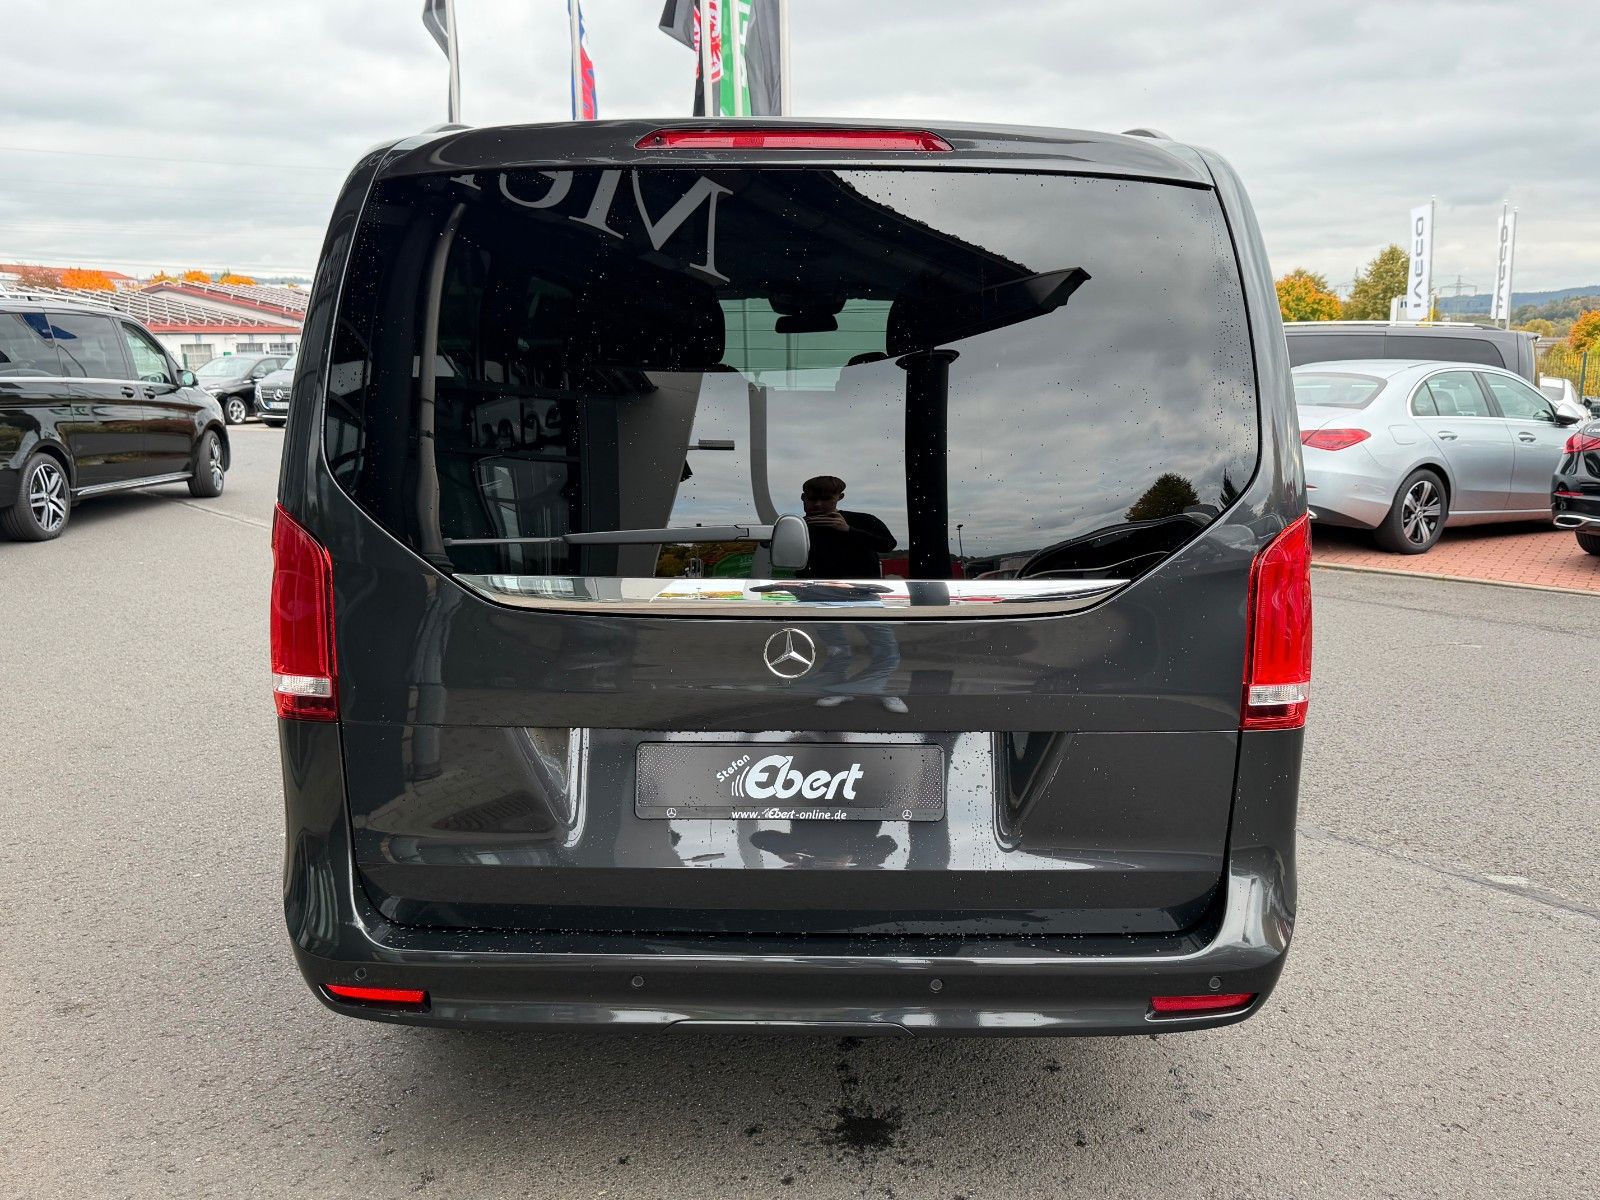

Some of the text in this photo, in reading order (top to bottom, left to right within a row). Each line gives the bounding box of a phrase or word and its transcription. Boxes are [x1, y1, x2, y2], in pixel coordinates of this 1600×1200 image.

[716, 754, 751, 783] Stefan
[745, 754, 864, 800] Ebert
[731, 807, 847, 820] www.Ebert-online.de
